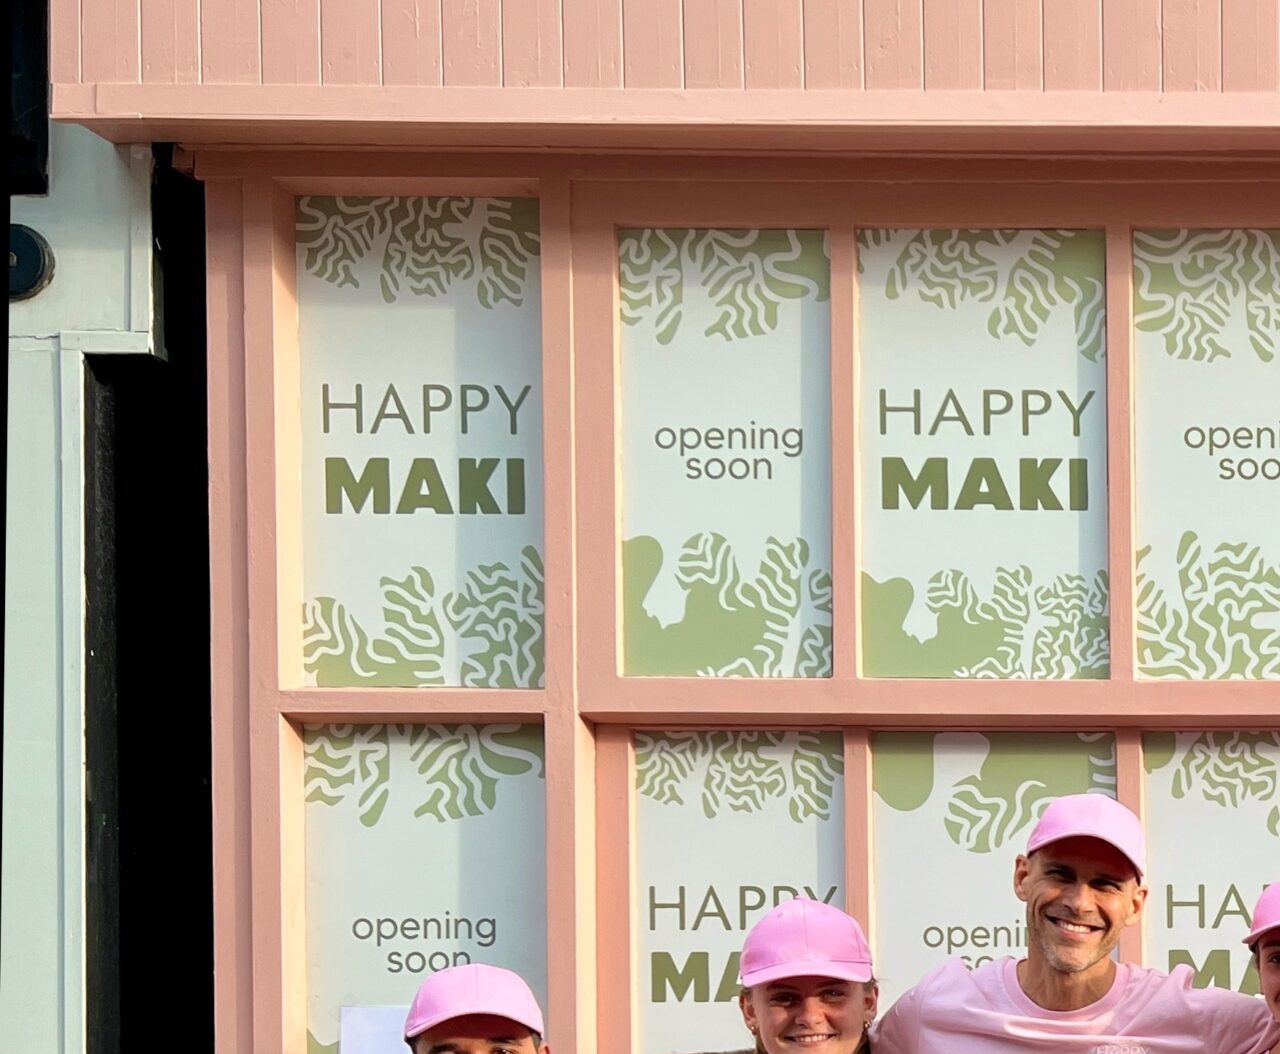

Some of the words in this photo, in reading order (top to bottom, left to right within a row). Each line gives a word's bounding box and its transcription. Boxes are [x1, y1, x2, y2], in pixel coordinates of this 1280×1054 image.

[322, 383, 532, 436] HAPPY
[879, 387, 1096, 437] HAPPY
[654, 420, 804, 458] opening
[324, 457, 526, 515] MAKI
[686, 457, 773, 481] soon
[881, 456, 1089, 511] MAKI
[351, 911, 497, 947] opening
[922, 919, 1029, 955] openi
